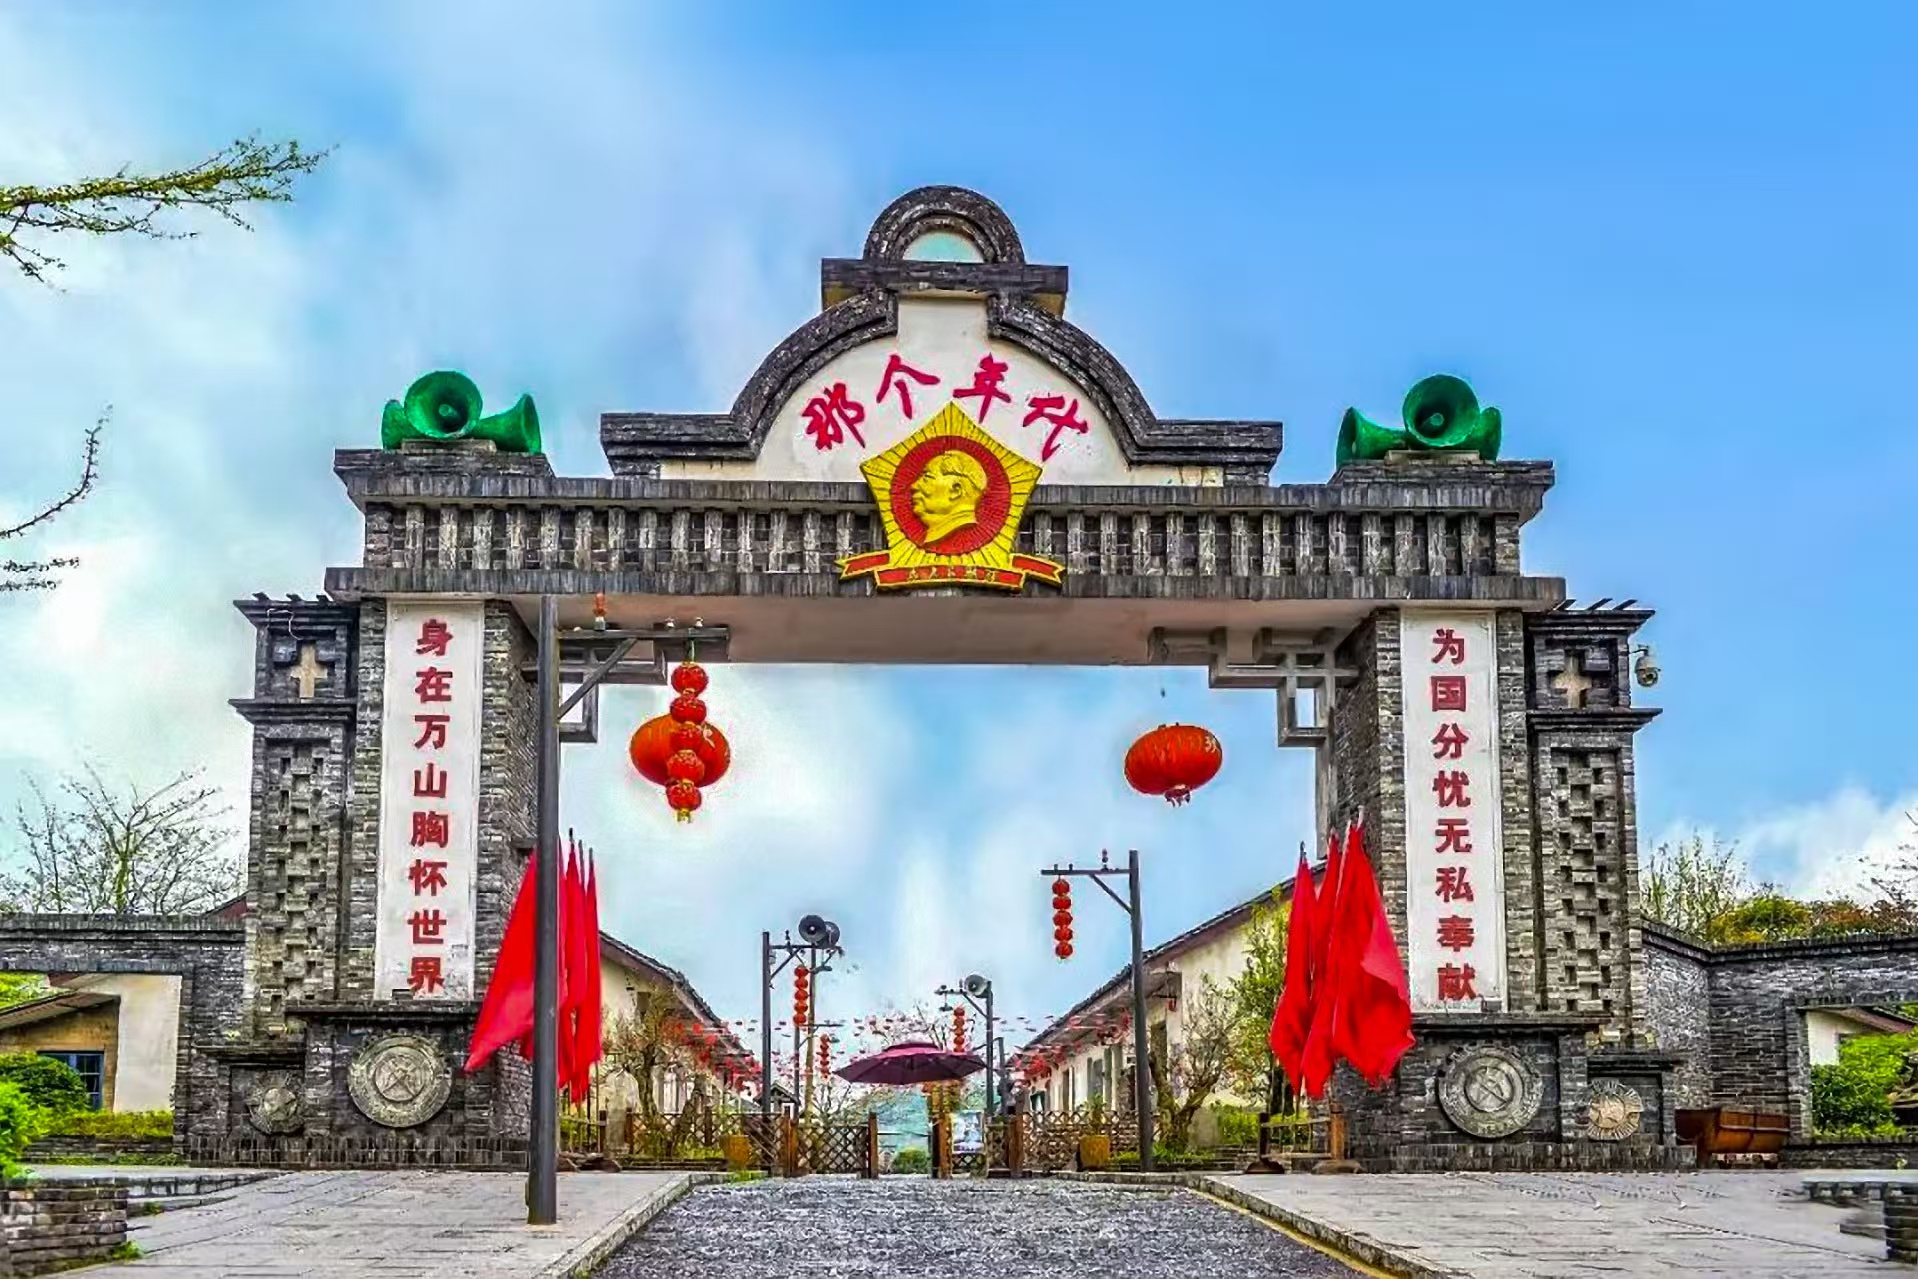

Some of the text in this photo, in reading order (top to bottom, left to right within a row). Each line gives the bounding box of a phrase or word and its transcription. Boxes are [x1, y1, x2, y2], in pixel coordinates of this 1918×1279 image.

[406, 618, 453, 994] 身在万山胸怀世界
[1430, 628, 1478, 1002] 为国分忧无私奉献
